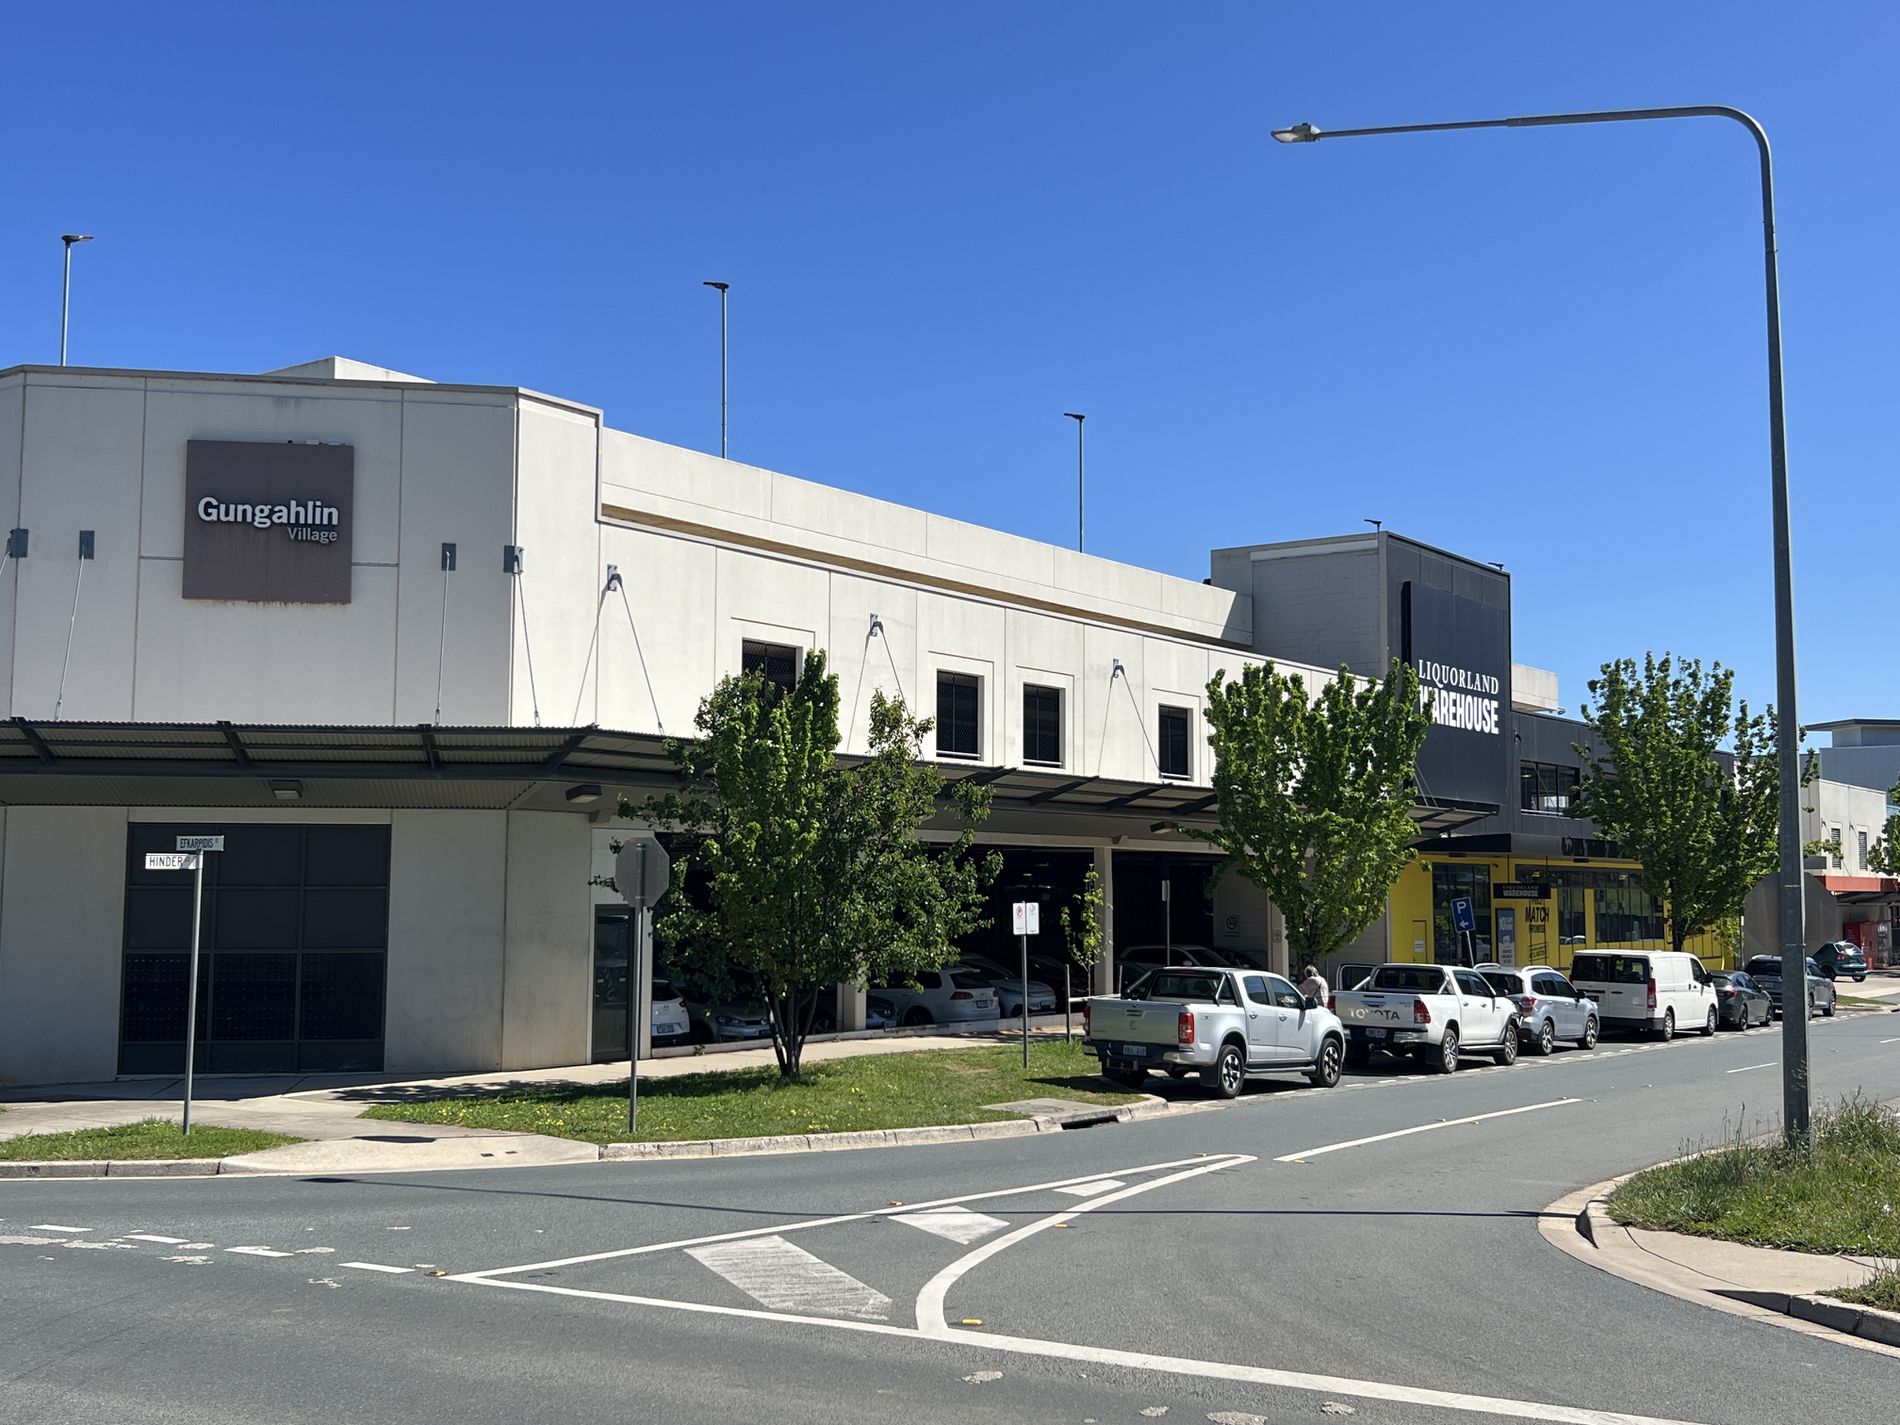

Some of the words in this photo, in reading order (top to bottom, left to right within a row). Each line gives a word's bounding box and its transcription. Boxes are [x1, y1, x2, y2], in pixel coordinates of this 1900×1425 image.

[198, 497, 339, 528] Gungahlin
[287, 527, 338, 544] Village
[1418, 659, 1499, 695] LIQUORLAND
[1418, 684, 1500, 735] WAREHOUSE
[149, 856, 183, 867] HINDER
[1502, 889, 1539, 897] WAREHOUSE
[1456, 901, 1467, 915] P
[1524, 906, 1550, 923] MATCH
